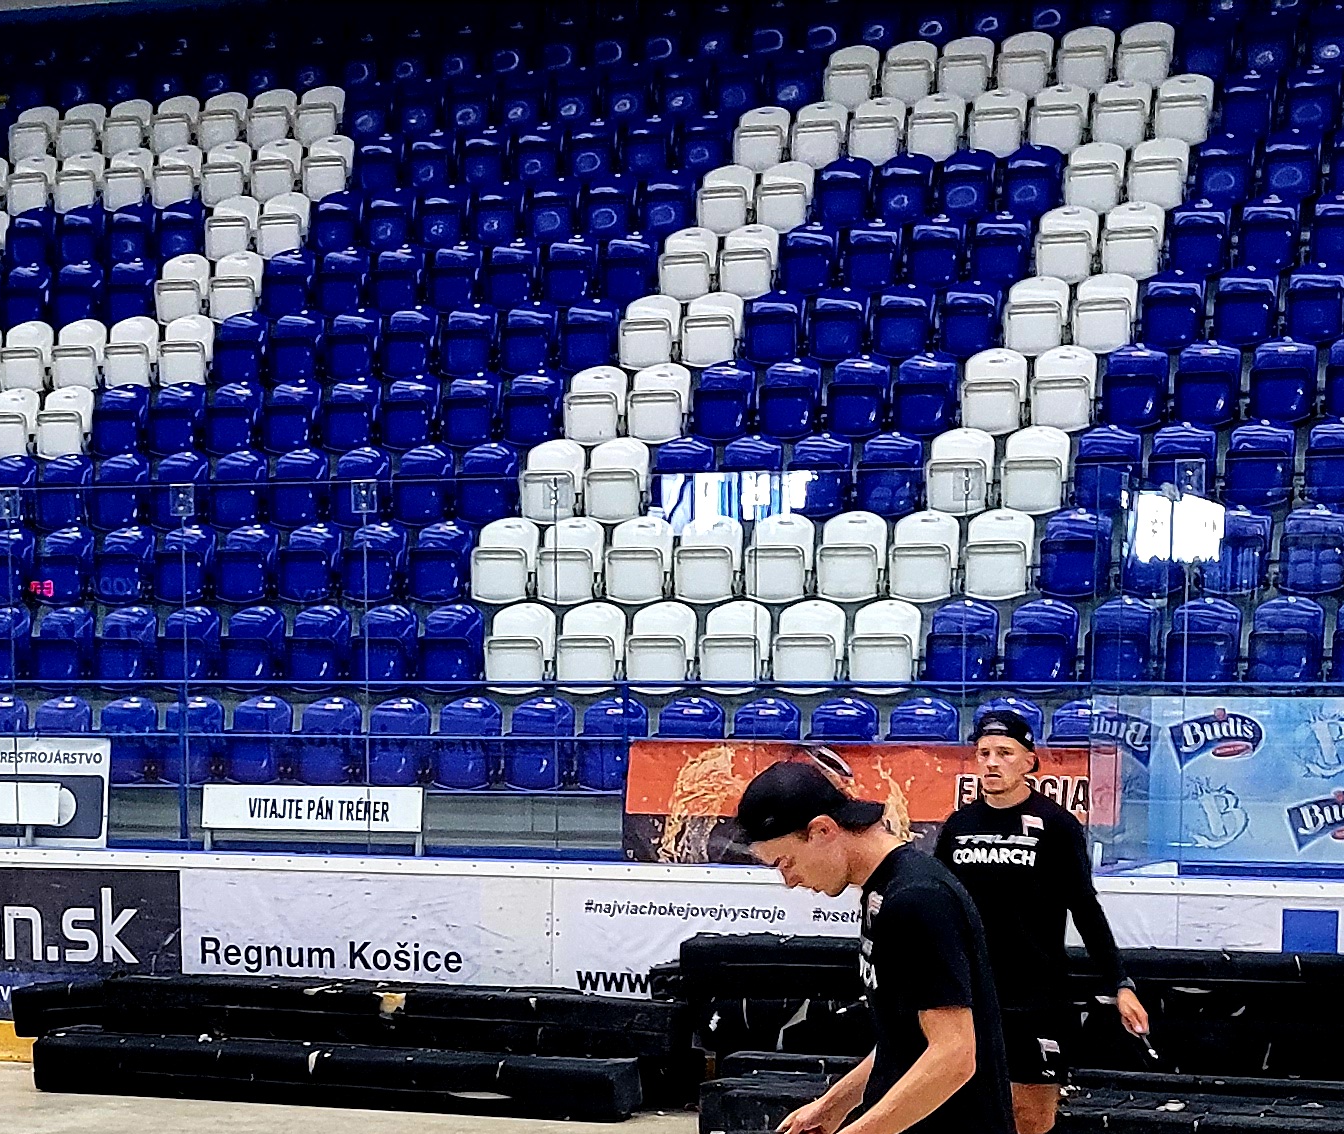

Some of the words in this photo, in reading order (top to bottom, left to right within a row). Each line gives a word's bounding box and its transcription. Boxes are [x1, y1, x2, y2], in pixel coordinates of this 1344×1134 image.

[1179, 717, 1255, 752] Budiš
[16, 749, 103, 765] STROJÁRSTVO
[248, 797, 303, 820] VITAJTE
[307, 796, 333, 821] PÁN
[339, 796, 390, 823] TRÉNER
[953, 847, 1037, 867] COMARCH
[584, 898, 787, 923] #najviachokejovejvystroje
[200, 936, 336, 974] Regnum
[348, 940, 464, 974] Košice
